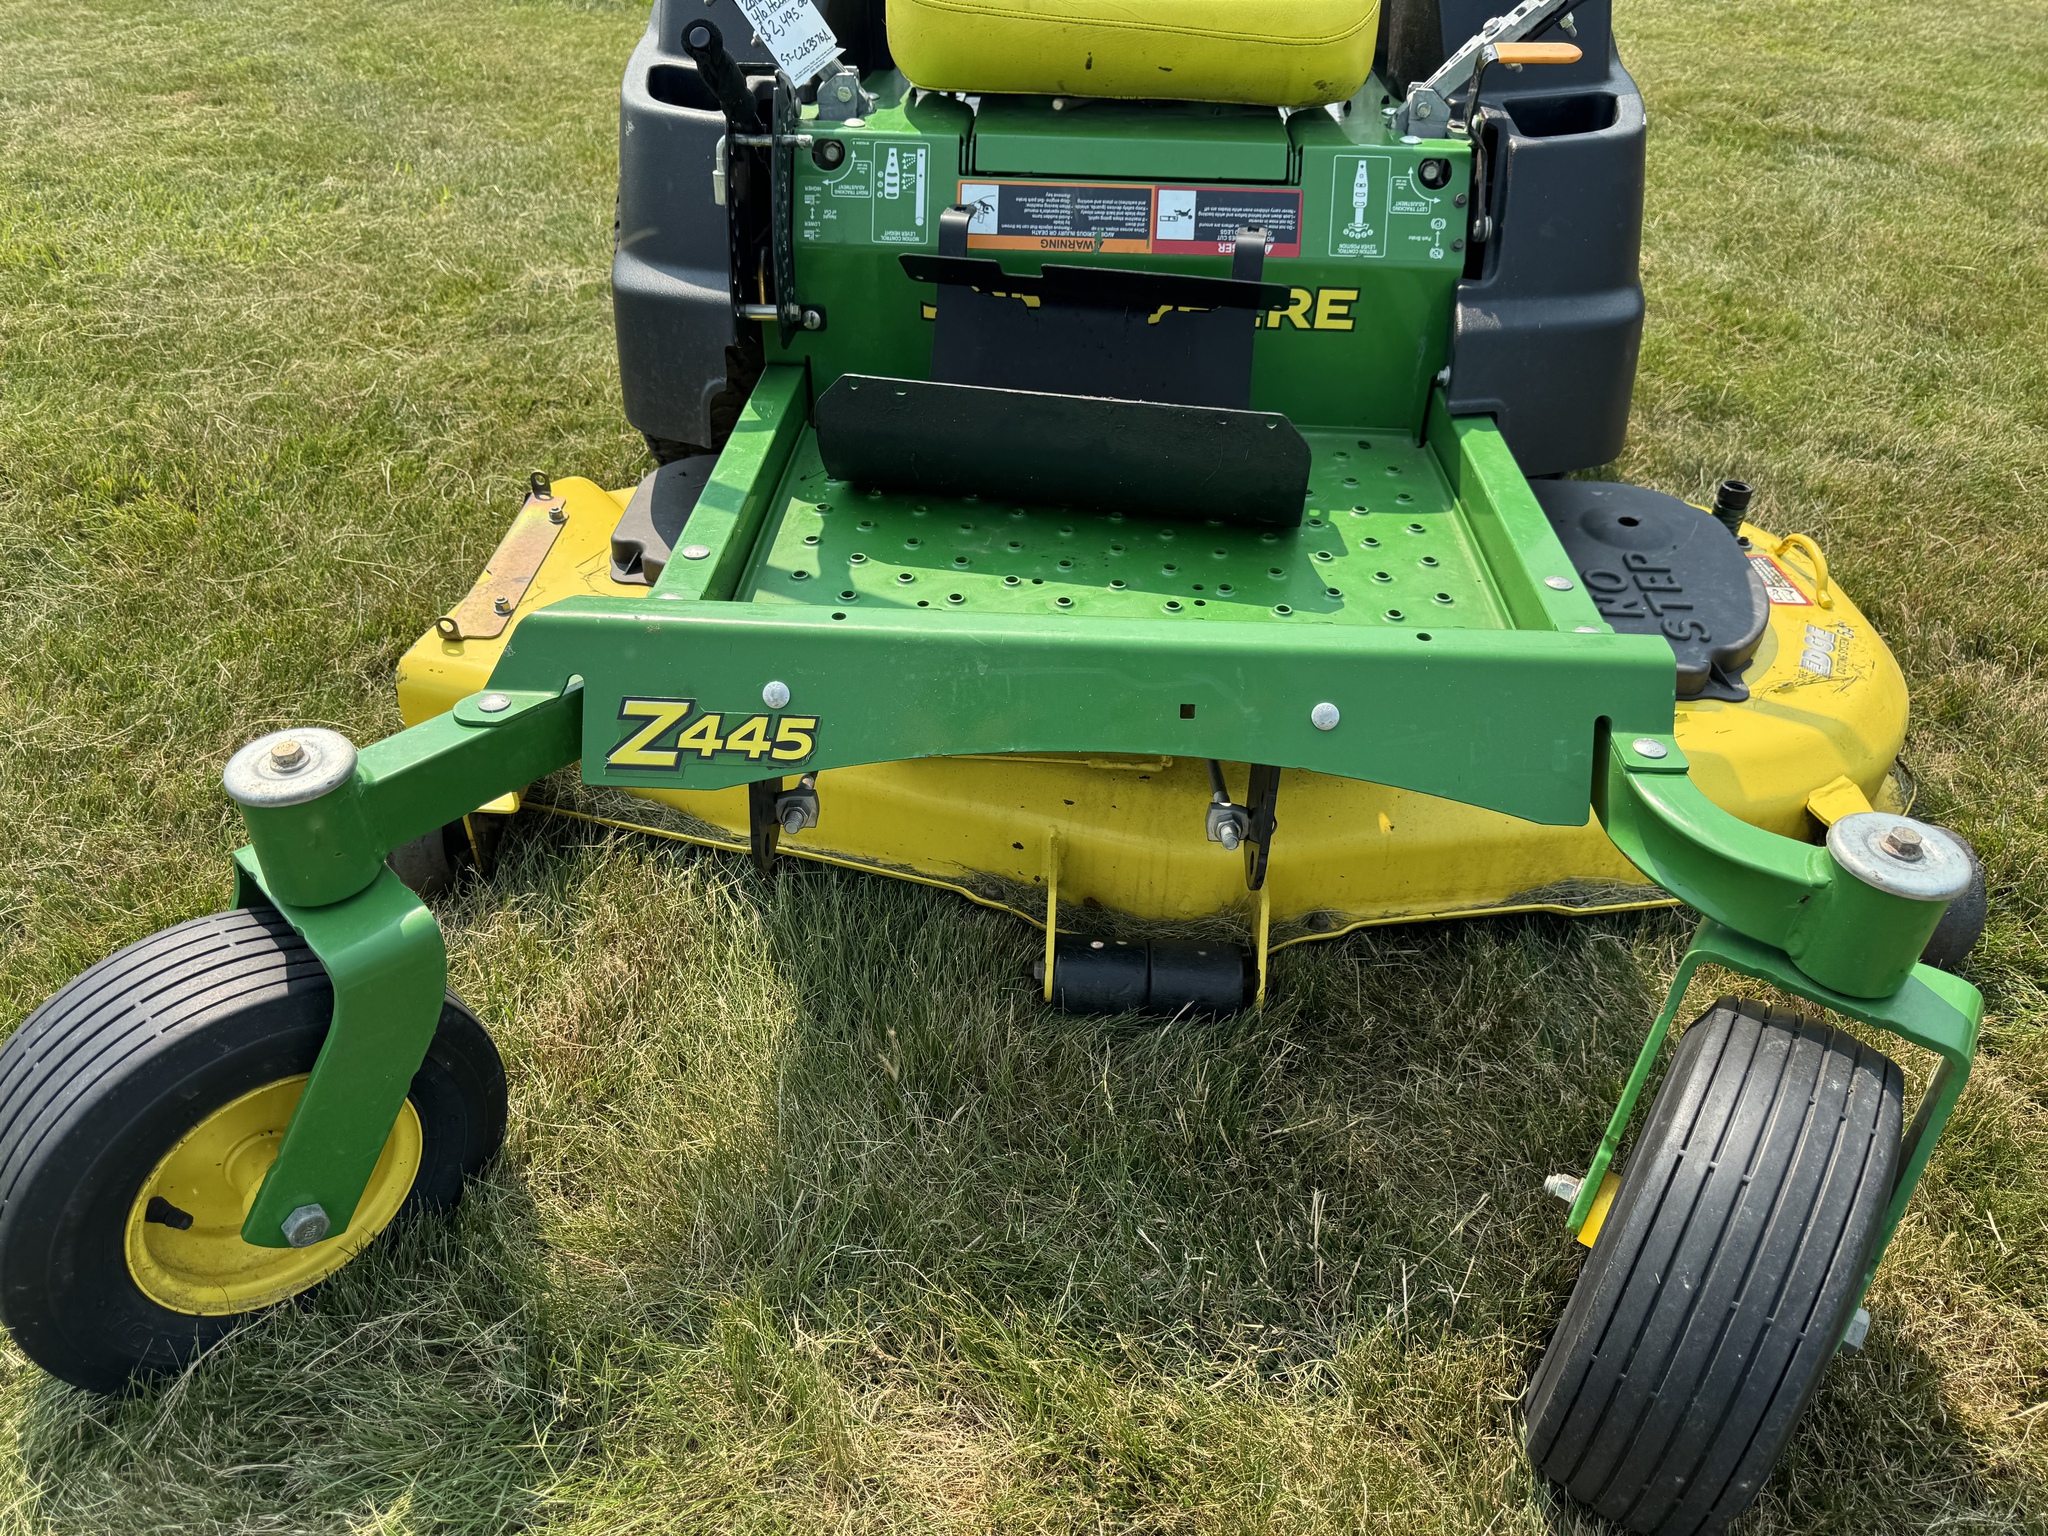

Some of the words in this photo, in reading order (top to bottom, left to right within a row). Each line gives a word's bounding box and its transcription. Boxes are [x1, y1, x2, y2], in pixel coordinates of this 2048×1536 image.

[1040, 239, 1094, 248] WARNING
[1581, 568, 1645, 618] NO
[1622, 551, 1711, 643] STEP
[1800, 624, 1836, 678] EDGE
[605, 695, 821, 772] Z445
